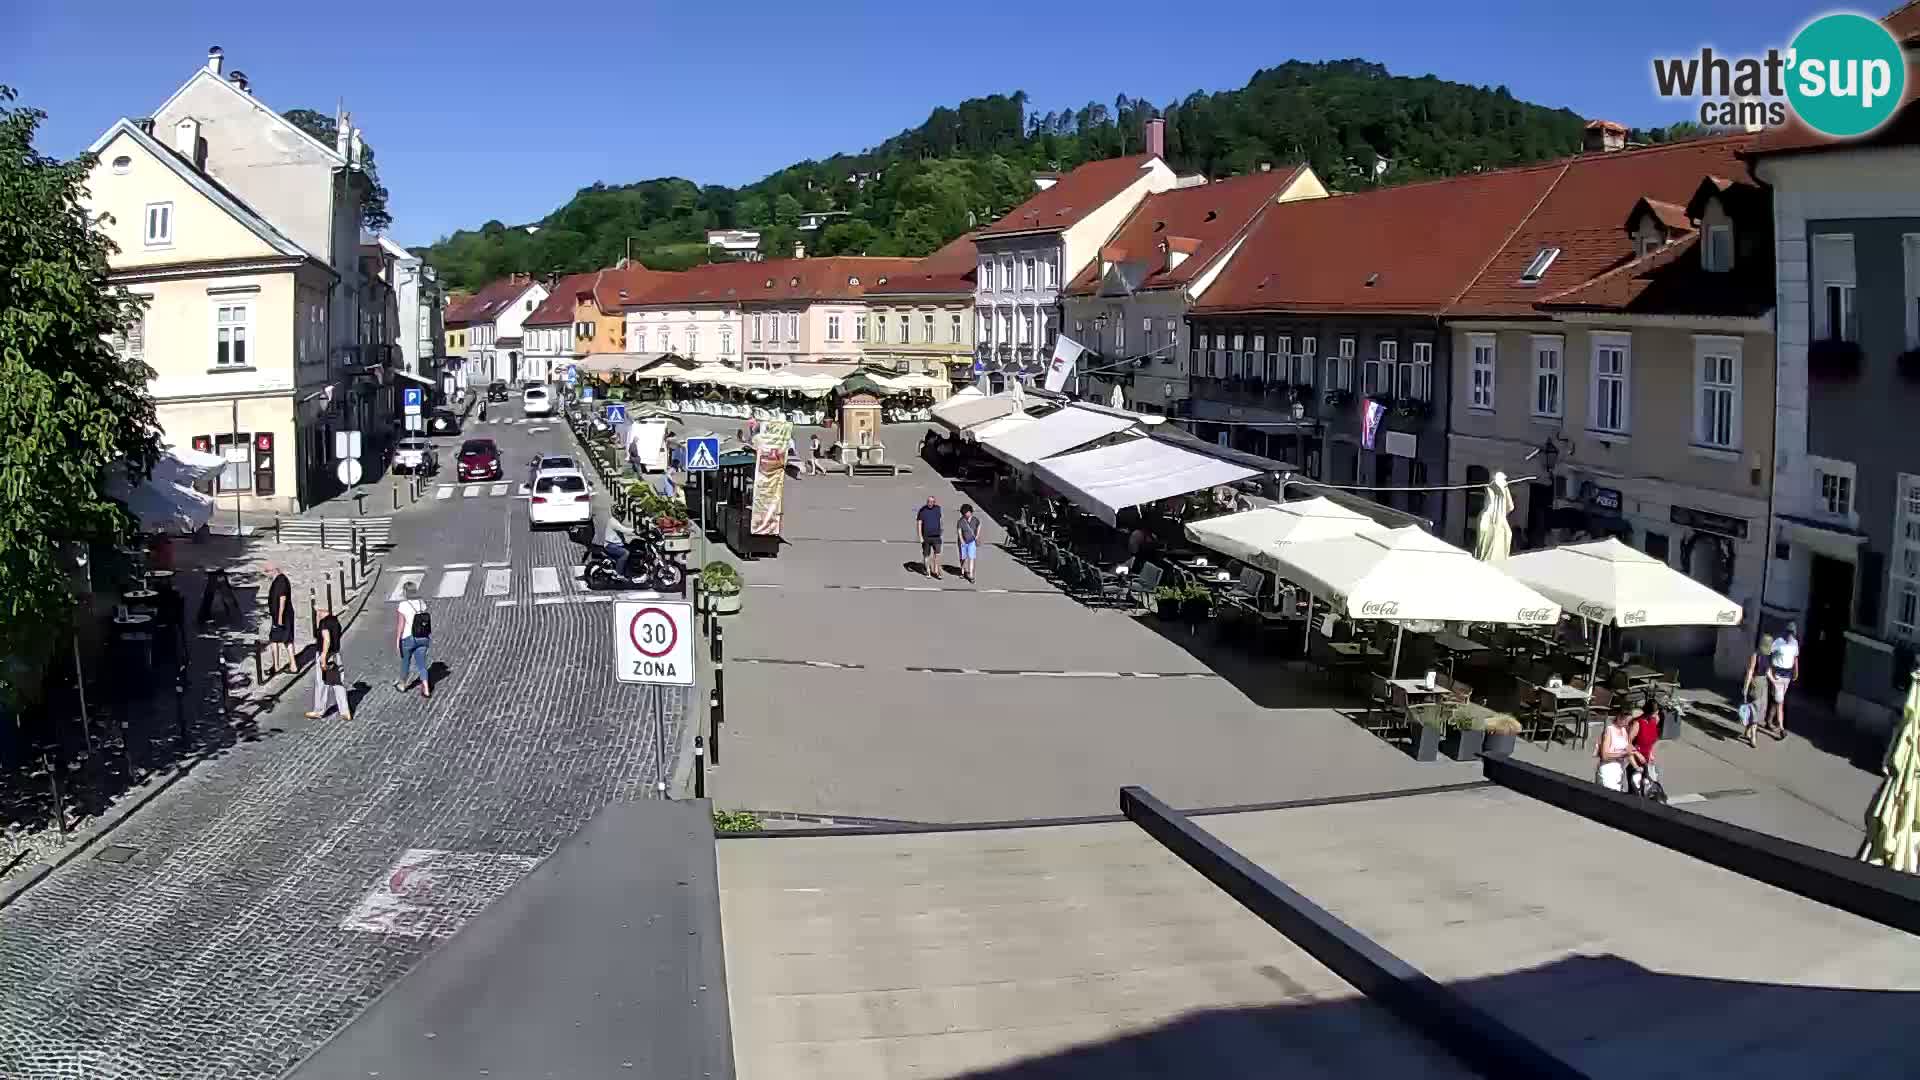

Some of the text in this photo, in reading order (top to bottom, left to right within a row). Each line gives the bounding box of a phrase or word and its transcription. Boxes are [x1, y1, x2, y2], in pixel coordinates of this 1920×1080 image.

[409, 392, 416, 402] P
[642, 623, 666, 644] 30
[632, 660, 677, 677] ZONA
